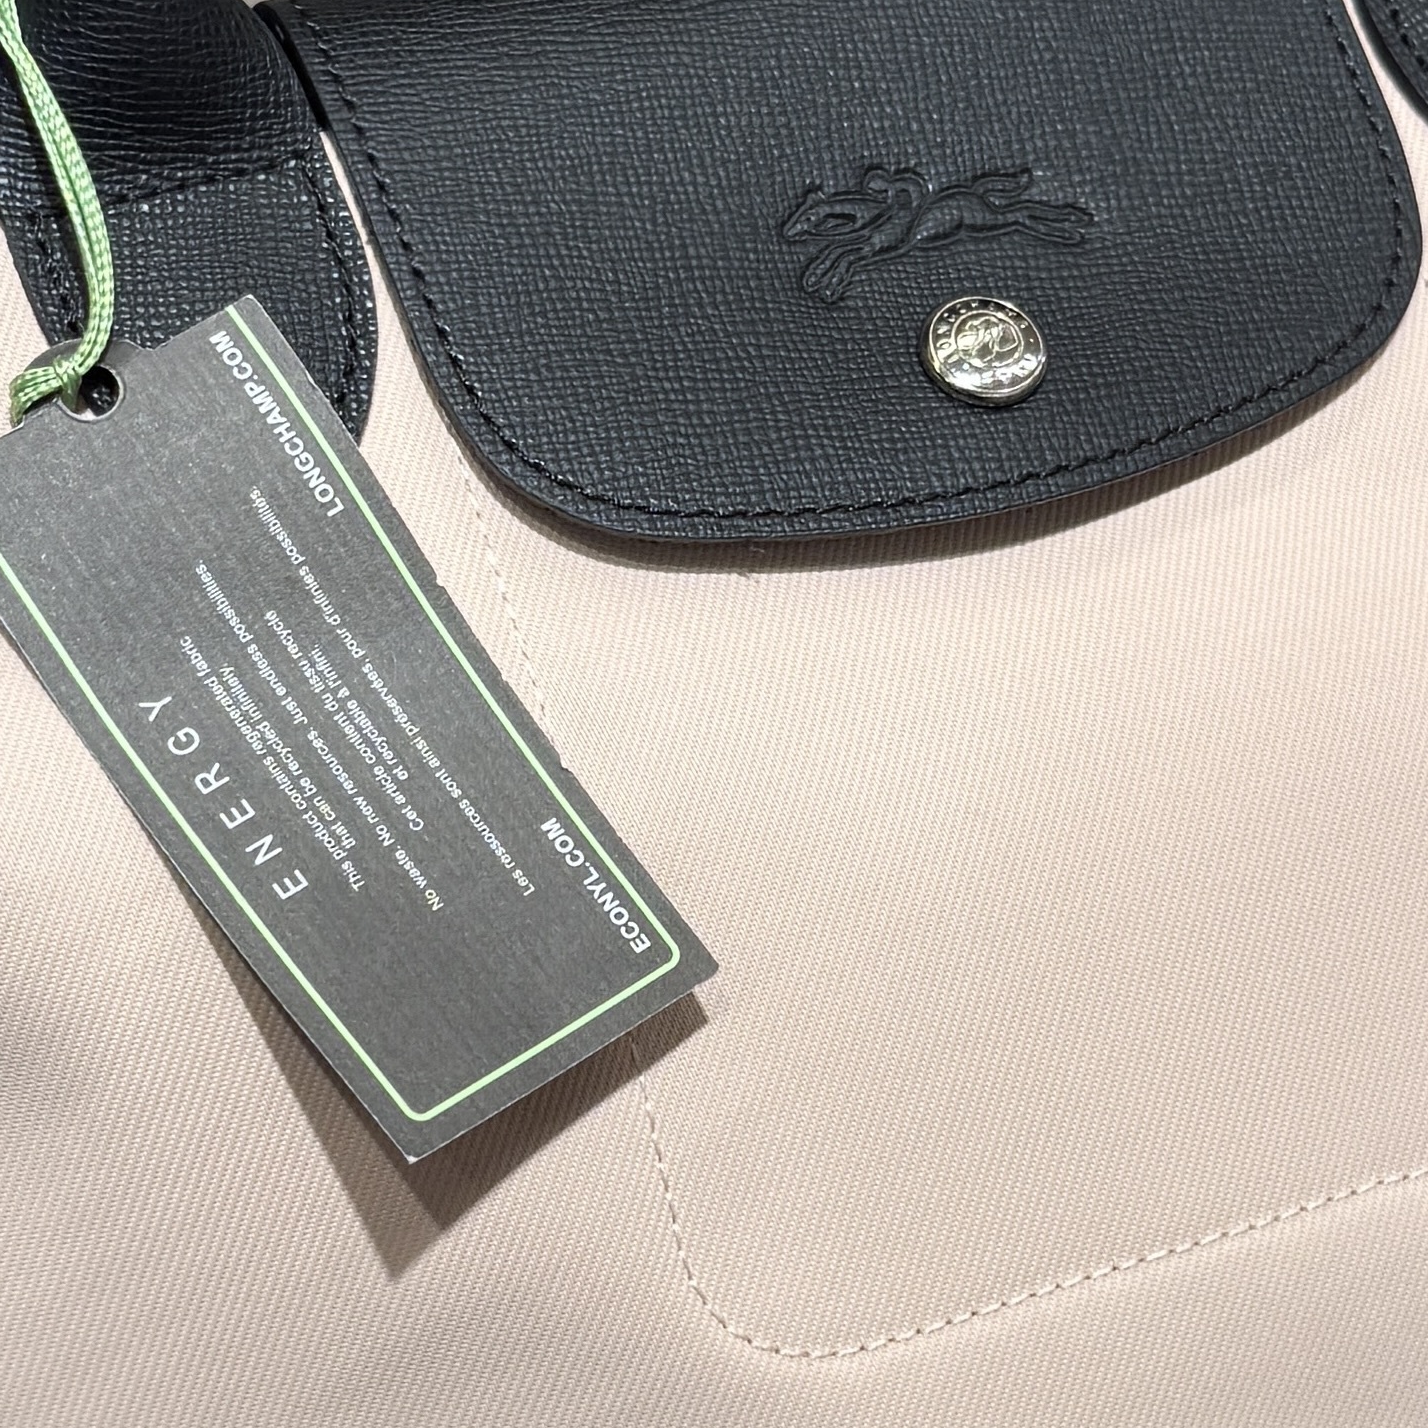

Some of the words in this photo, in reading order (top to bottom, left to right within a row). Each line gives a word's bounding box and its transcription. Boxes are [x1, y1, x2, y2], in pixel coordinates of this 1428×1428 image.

[208, 330, 345, 517] LONGCHAMP.COM
[195, 559, 254, 643] possibilities.
[298, 565, 341, 626] d'infinies
[179, 635, 212, 677] fabric
[335, 627, 367, 659] pour
[246, 643, 287, 697] endless
[298, 659, 326, 694] tissu
[203, 675, 268, 755] regenerated
[280, 696, 309, 725] Just
[321, 692, 339, 712] du
[255, 720, 303, 776] recycled
[333, 711, 377, 765] contient
[346, 699, 398, 766] recyclable
[409, 736, 441, 769] ainsi
[306, 726, 359, 795] resources.
[391, 764, 409, 781] et
[137, 695, 309, 900] ENERGY
[262, 755, 308, 810] contains
[299, 776, 318, 798] be
[373, 765, 407, 805] article
[434, 768, 463, 799] sont
[312, 795, 337, 821] can
[352, 796, 380, 824] new
[400, 804, 425, 831] Cet
[301, 810, 348, 861] product
[329, 821, 357, 850] that
[375, 824, 396, 847] No
[458, 798, 516, 869] ressources
[340, 860, 366, 892] This
[394, 845, 428, 889] waste.
[511, 868, 536, 897] Les
[539, 817, 652, 954] ECONYL.COM
[424, 888, 445, 912] No
